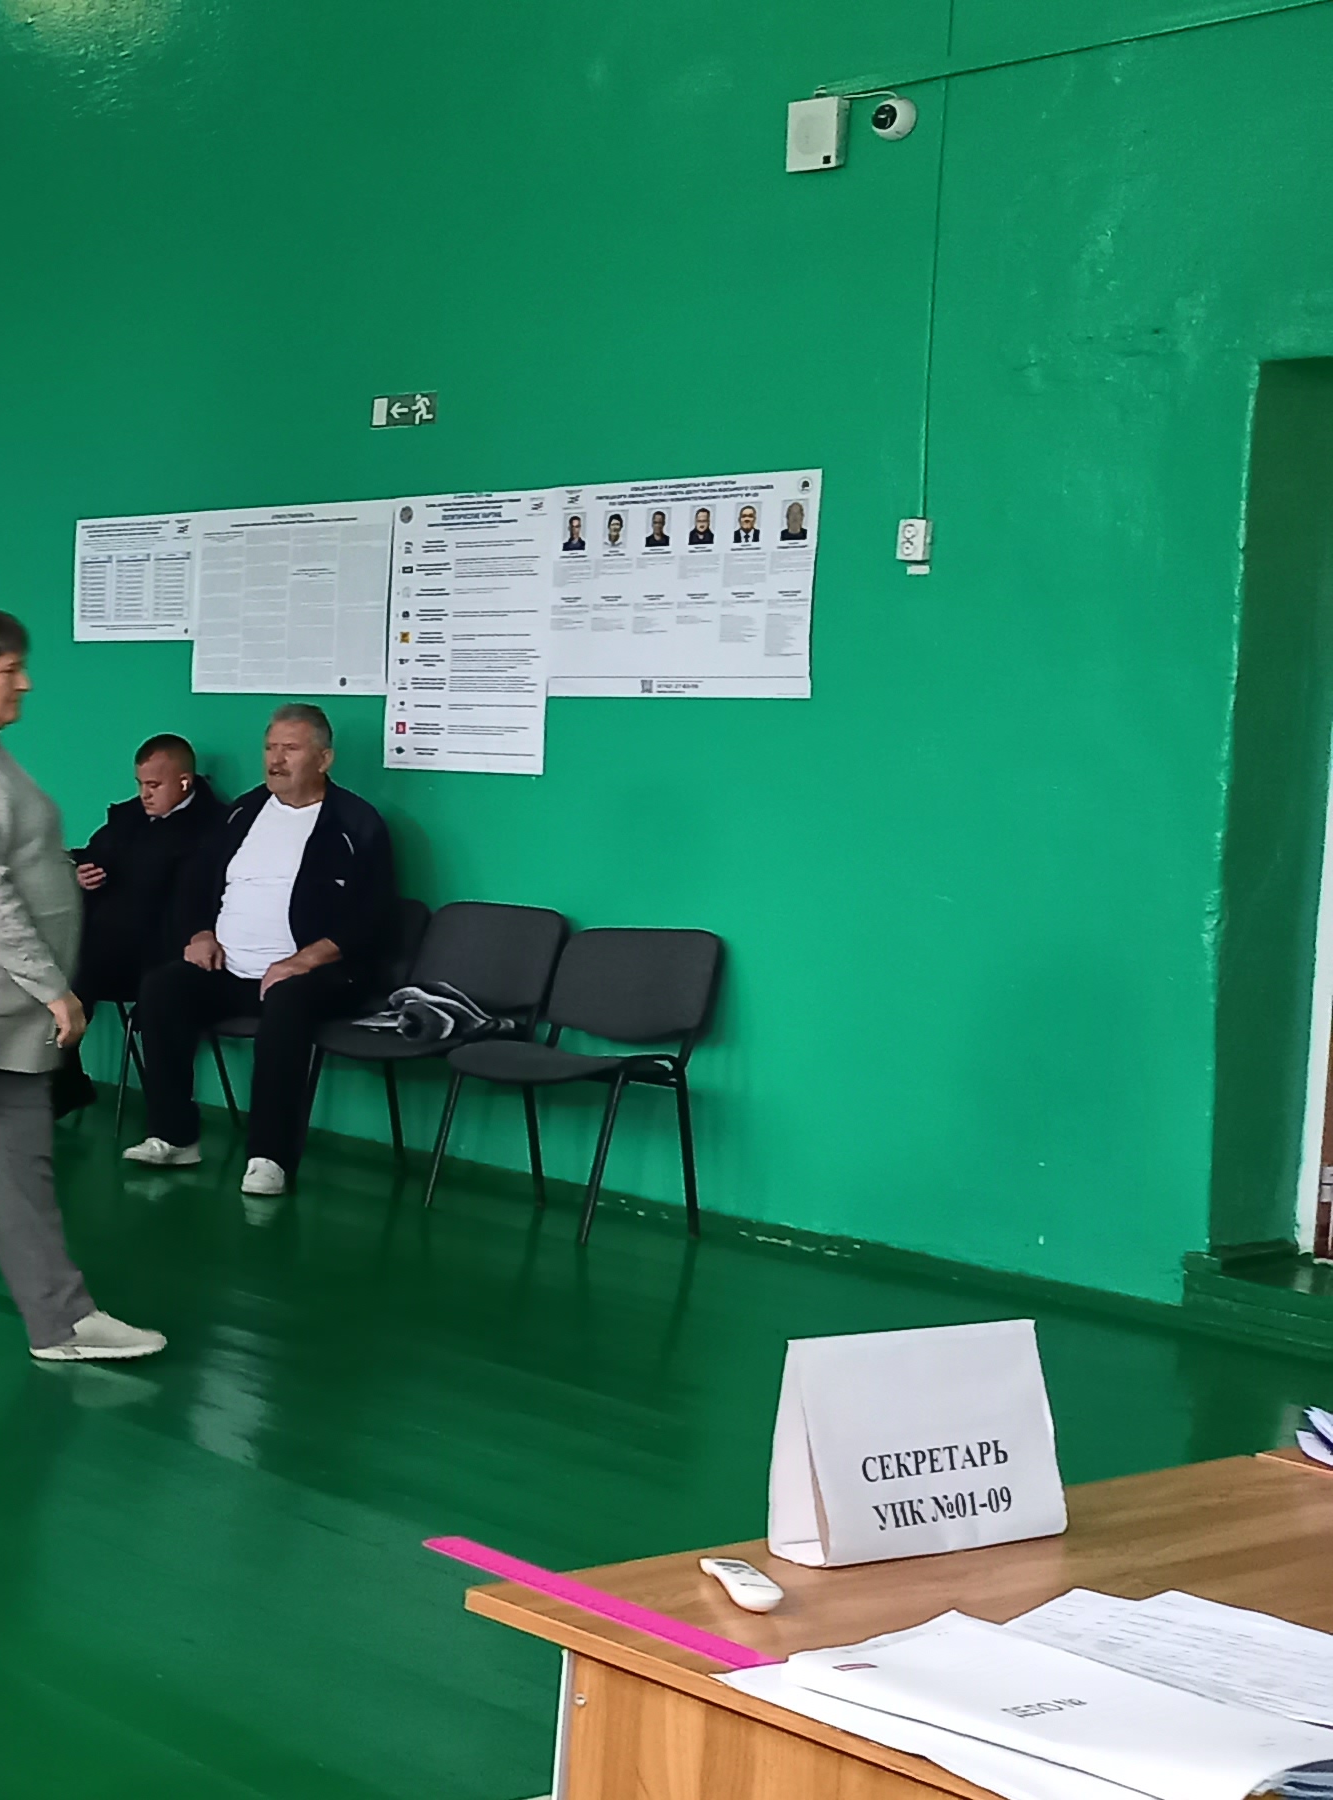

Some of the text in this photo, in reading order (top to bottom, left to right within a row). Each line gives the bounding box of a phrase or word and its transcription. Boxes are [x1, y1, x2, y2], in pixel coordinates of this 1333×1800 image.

[861, 1439, 1008, 1483] СЕКРЕТАРЬ
[872, 1486, 1012, 1531] УИК №01-09
